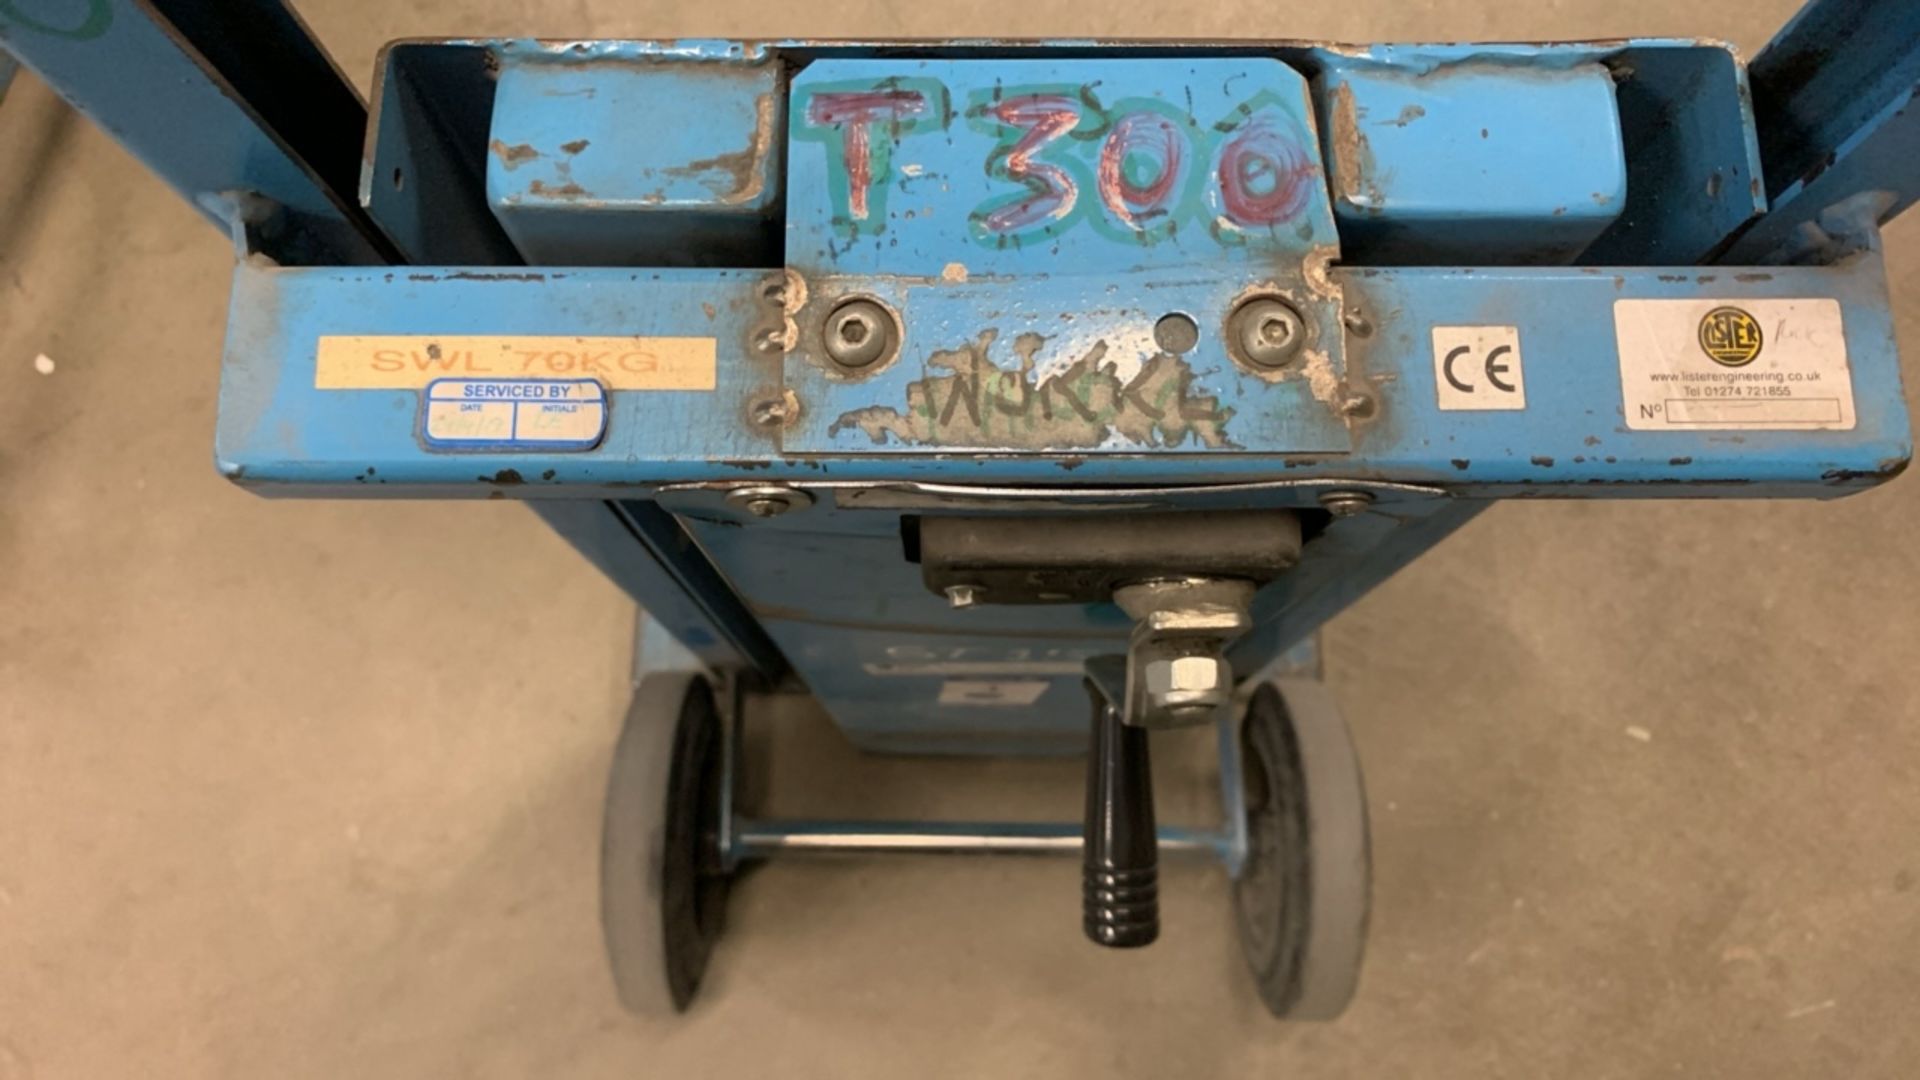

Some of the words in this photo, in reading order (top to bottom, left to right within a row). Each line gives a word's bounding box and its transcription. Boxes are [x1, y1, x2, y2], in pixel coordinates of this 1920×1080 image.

[799, 86, 934, 224] T
[977, 87, 1319, 236] 300
[1703, 311, 1758, 349] LISTER
[371, 350, 492, 373] SWL
[514, 350, 660, 373] 70KG
[1443, 345, 1516, 393] CE
[1650, 371, 1822, 384] www.listerengineering.co.uk
[464, 384, 544, 398] SERVICED
[549, 384, 571, 398] BY
[1683, 386, 1701, 397] Tel
[1704, 386, 1742, 397] 01274
[1747, 386, 1792, 397] 721855
[460, 403, 483, 412] DATE
[542, 403, 577, 413] INITIALS
